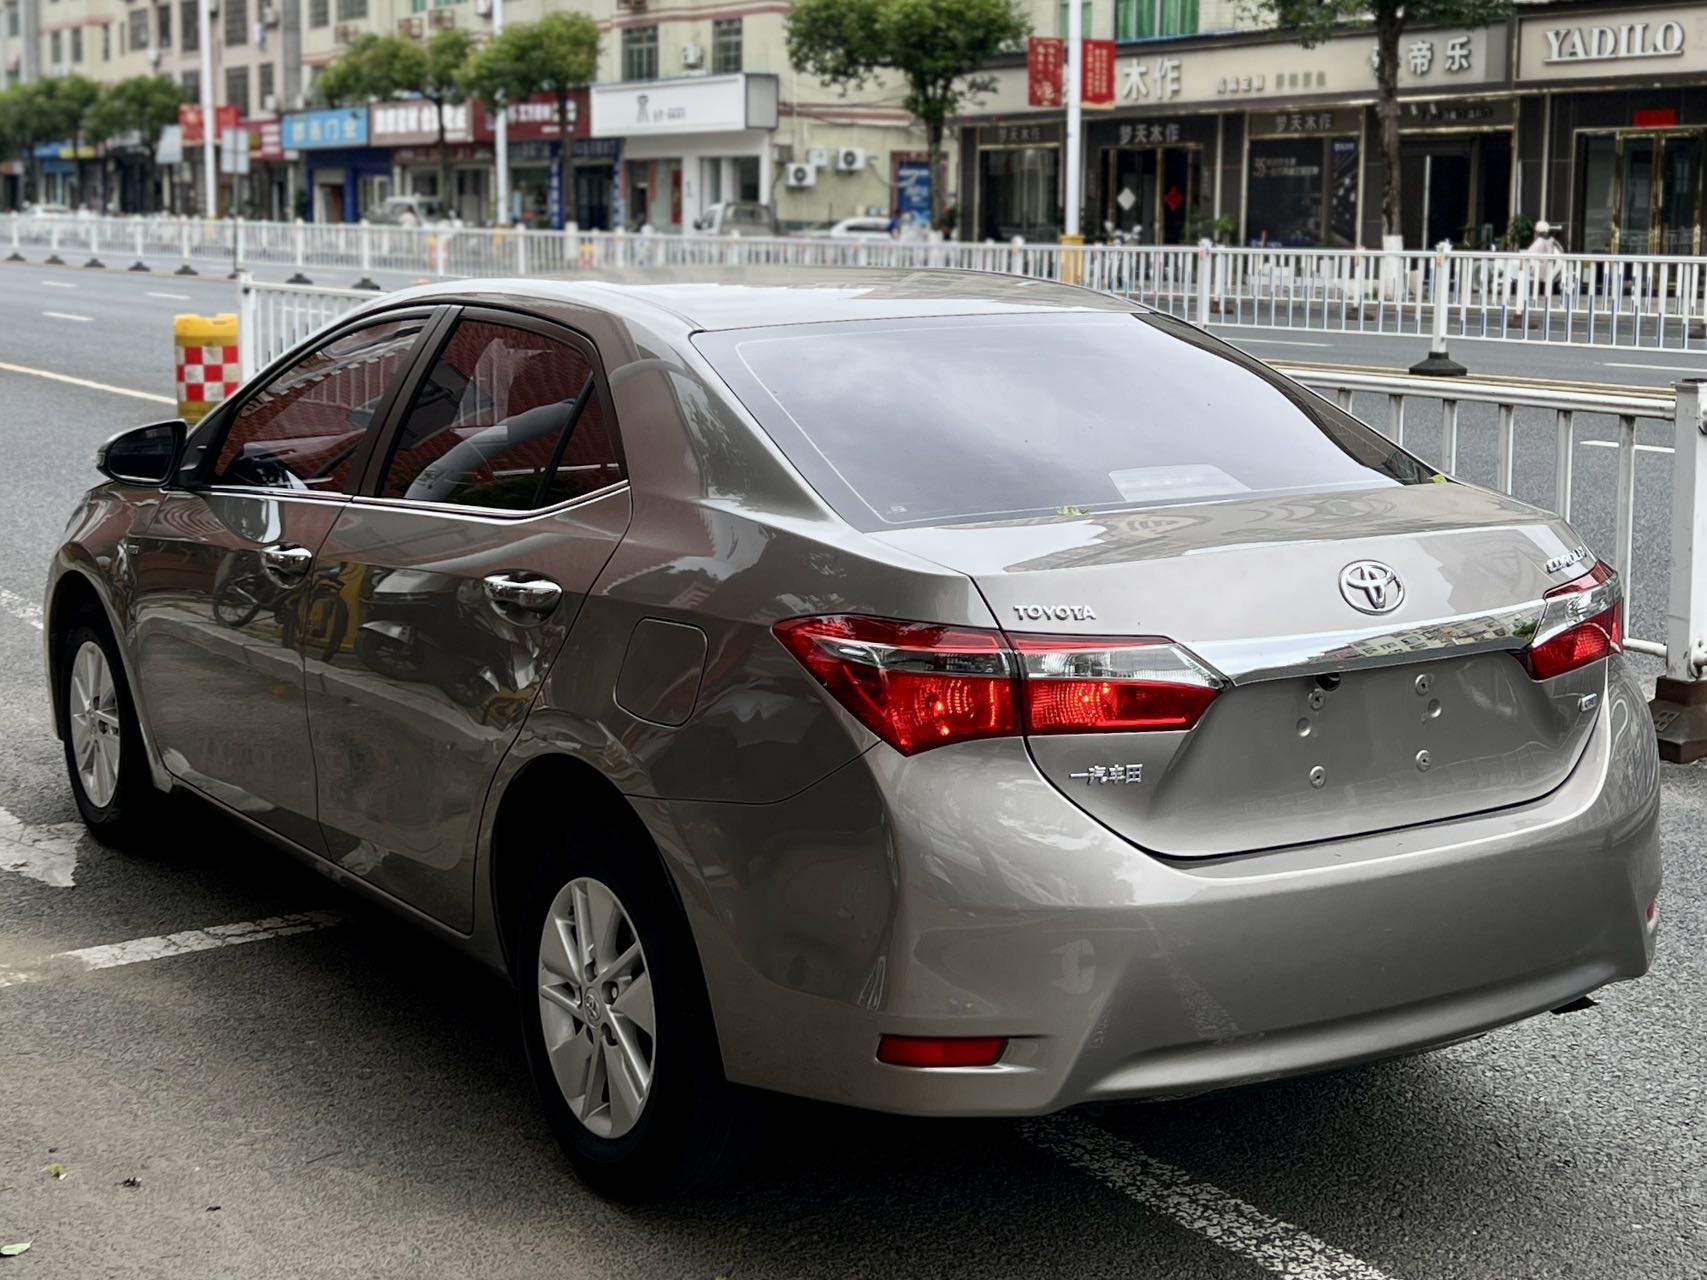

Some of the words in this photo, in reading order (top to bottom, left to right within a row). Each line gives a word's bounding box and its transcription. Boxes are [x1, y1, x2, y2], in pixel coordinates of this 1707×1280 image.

[1543, 20, 1685, 66] YADILO
[1119, 123, 1181, 145] 梦天木作
[1013, 604, 1097, 621] TOYOTA
[1069, 763, 1143, 785] 一汽丰田
